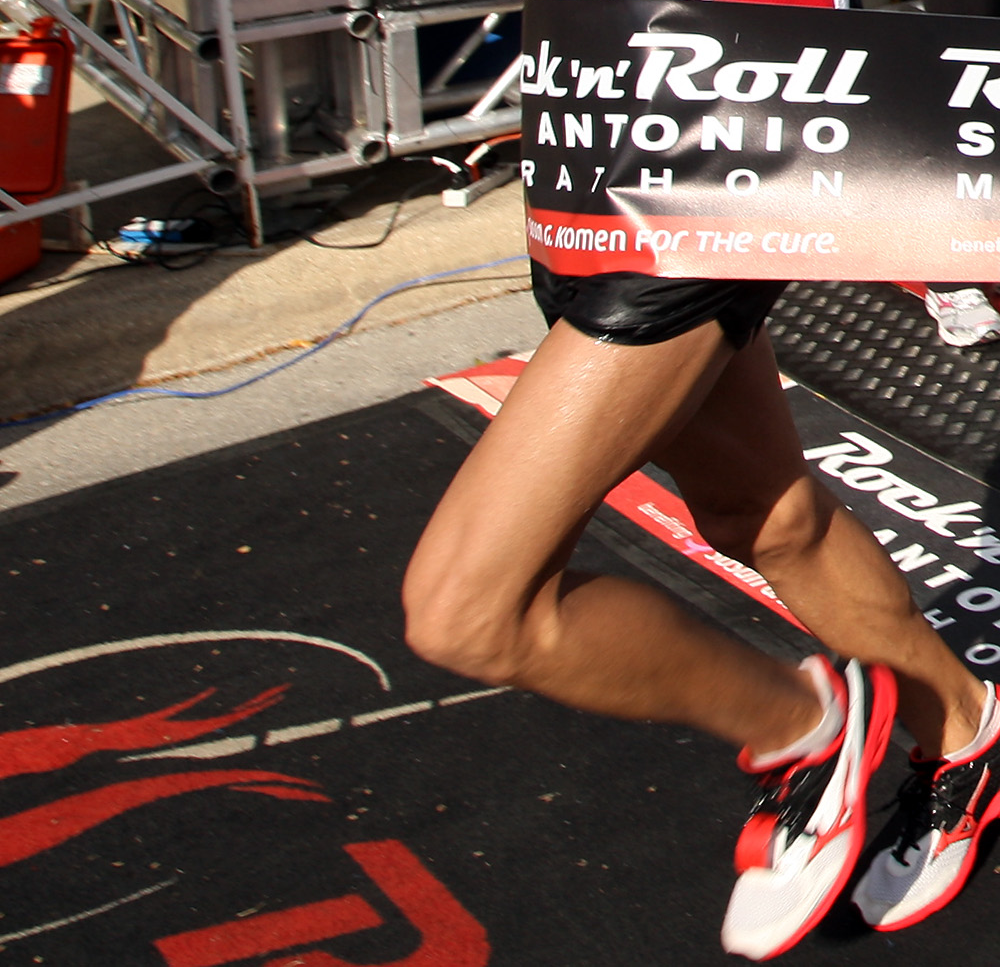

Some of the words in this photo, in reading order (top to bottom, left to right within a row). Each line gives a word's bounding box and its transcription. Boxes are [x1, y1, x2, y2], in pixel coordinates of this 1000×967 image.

[627, 31, 871, 105] Roll
[537, 110, 851, 155] ANTONIO
[802, 431, 983, 538] Rock
